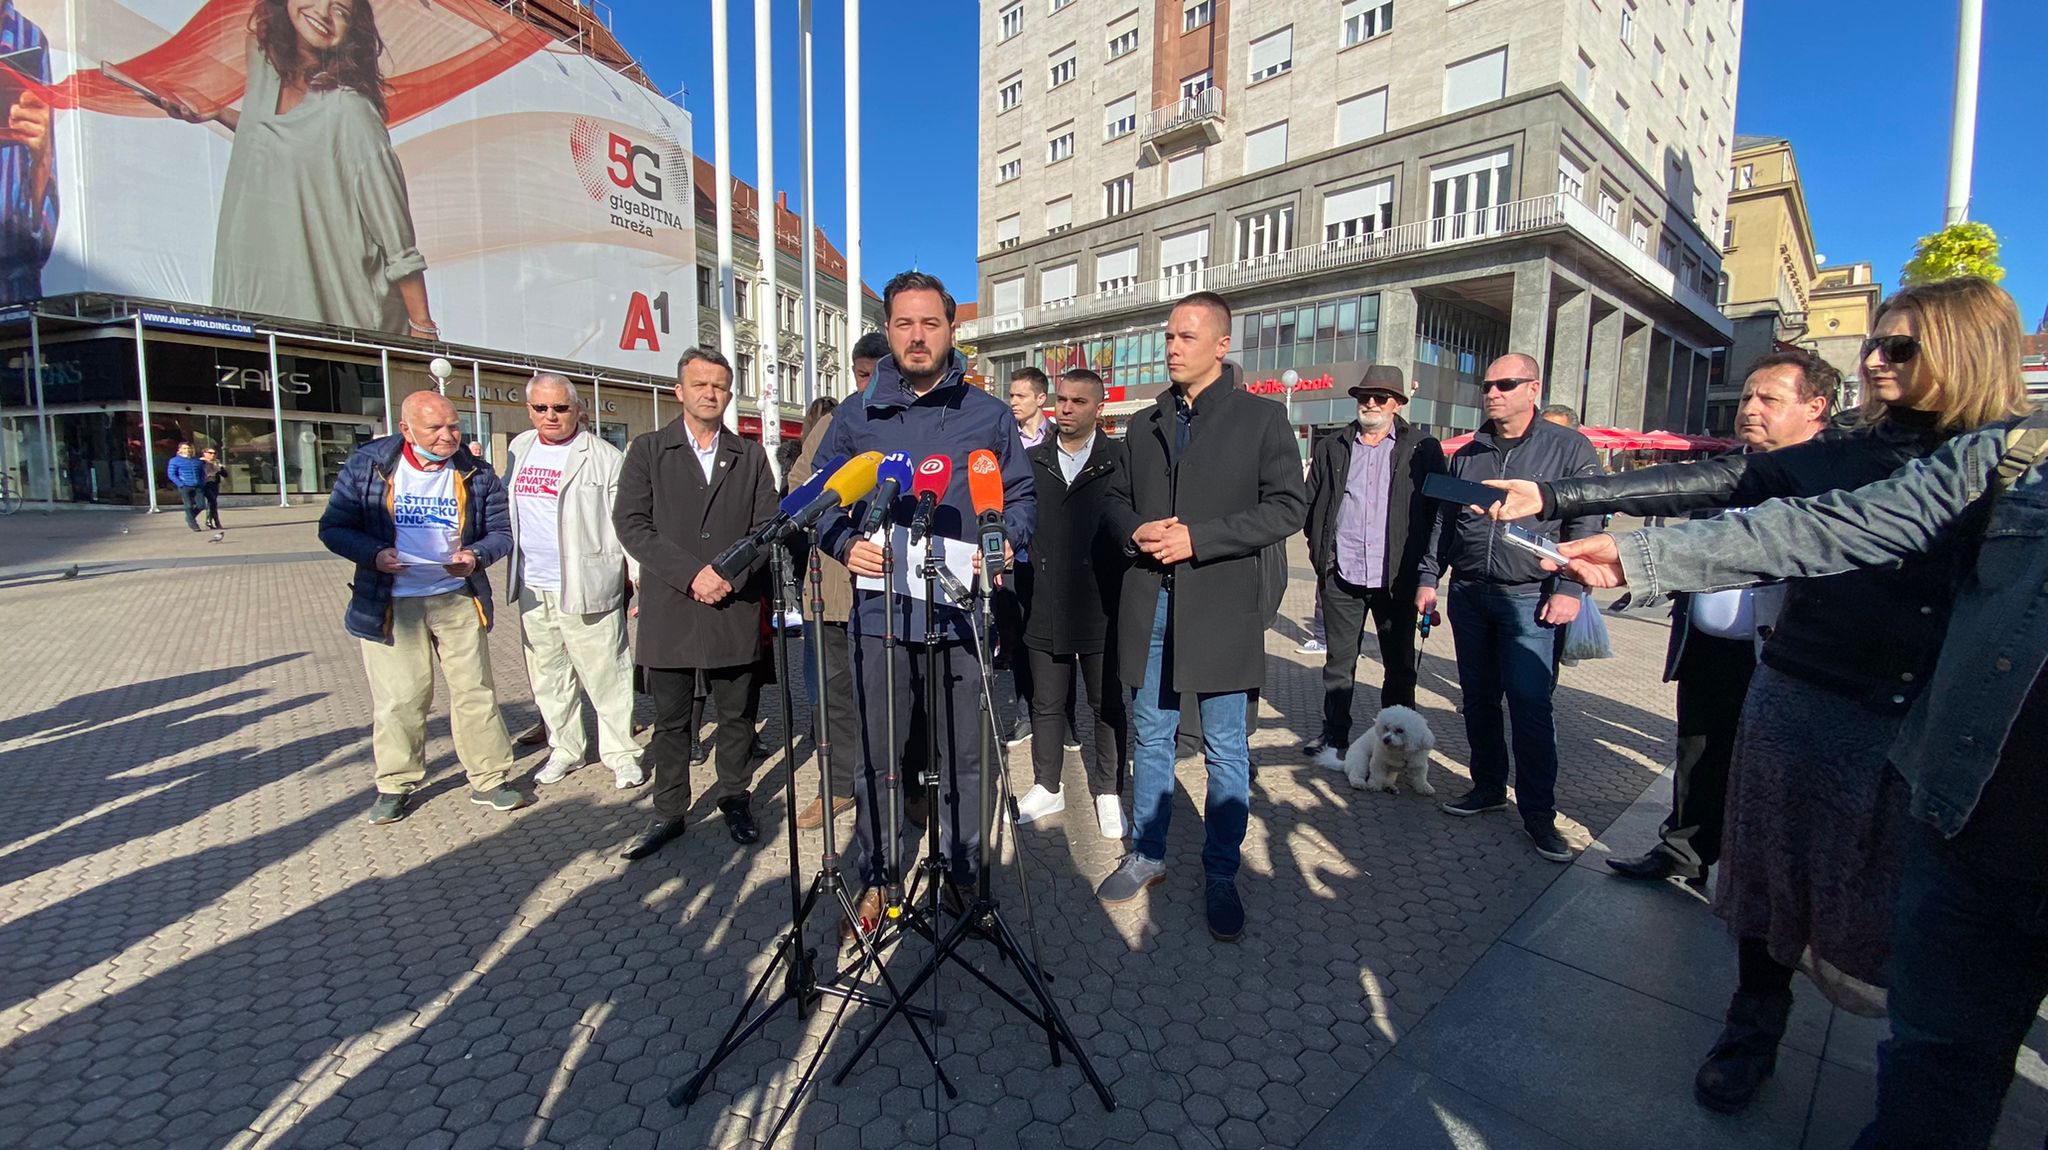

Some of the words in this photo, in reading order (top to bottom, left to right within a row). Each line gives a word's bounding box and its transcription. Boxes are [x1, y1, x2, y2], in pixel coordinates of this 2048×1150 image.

[607, 132, 662, 200] 5G
[610, 193, 683, 231] gigaBITNA
[610, 213, 654, 238] mreža
[142, 313, 252, 333] WWW.ANIC-HOLDING.COM
[619, 290, 670, 352] A1
[214, 365, 312, 395] ZAKS
[517, 475, 560, 487] RVATSK
[519, 465, 563, 478] AŠTITIM
[394, 492, 458, 507] AŠTITIMO
[395, 505, 458, 517] RVATSKU
[395, 515, 425, 525] UNU
